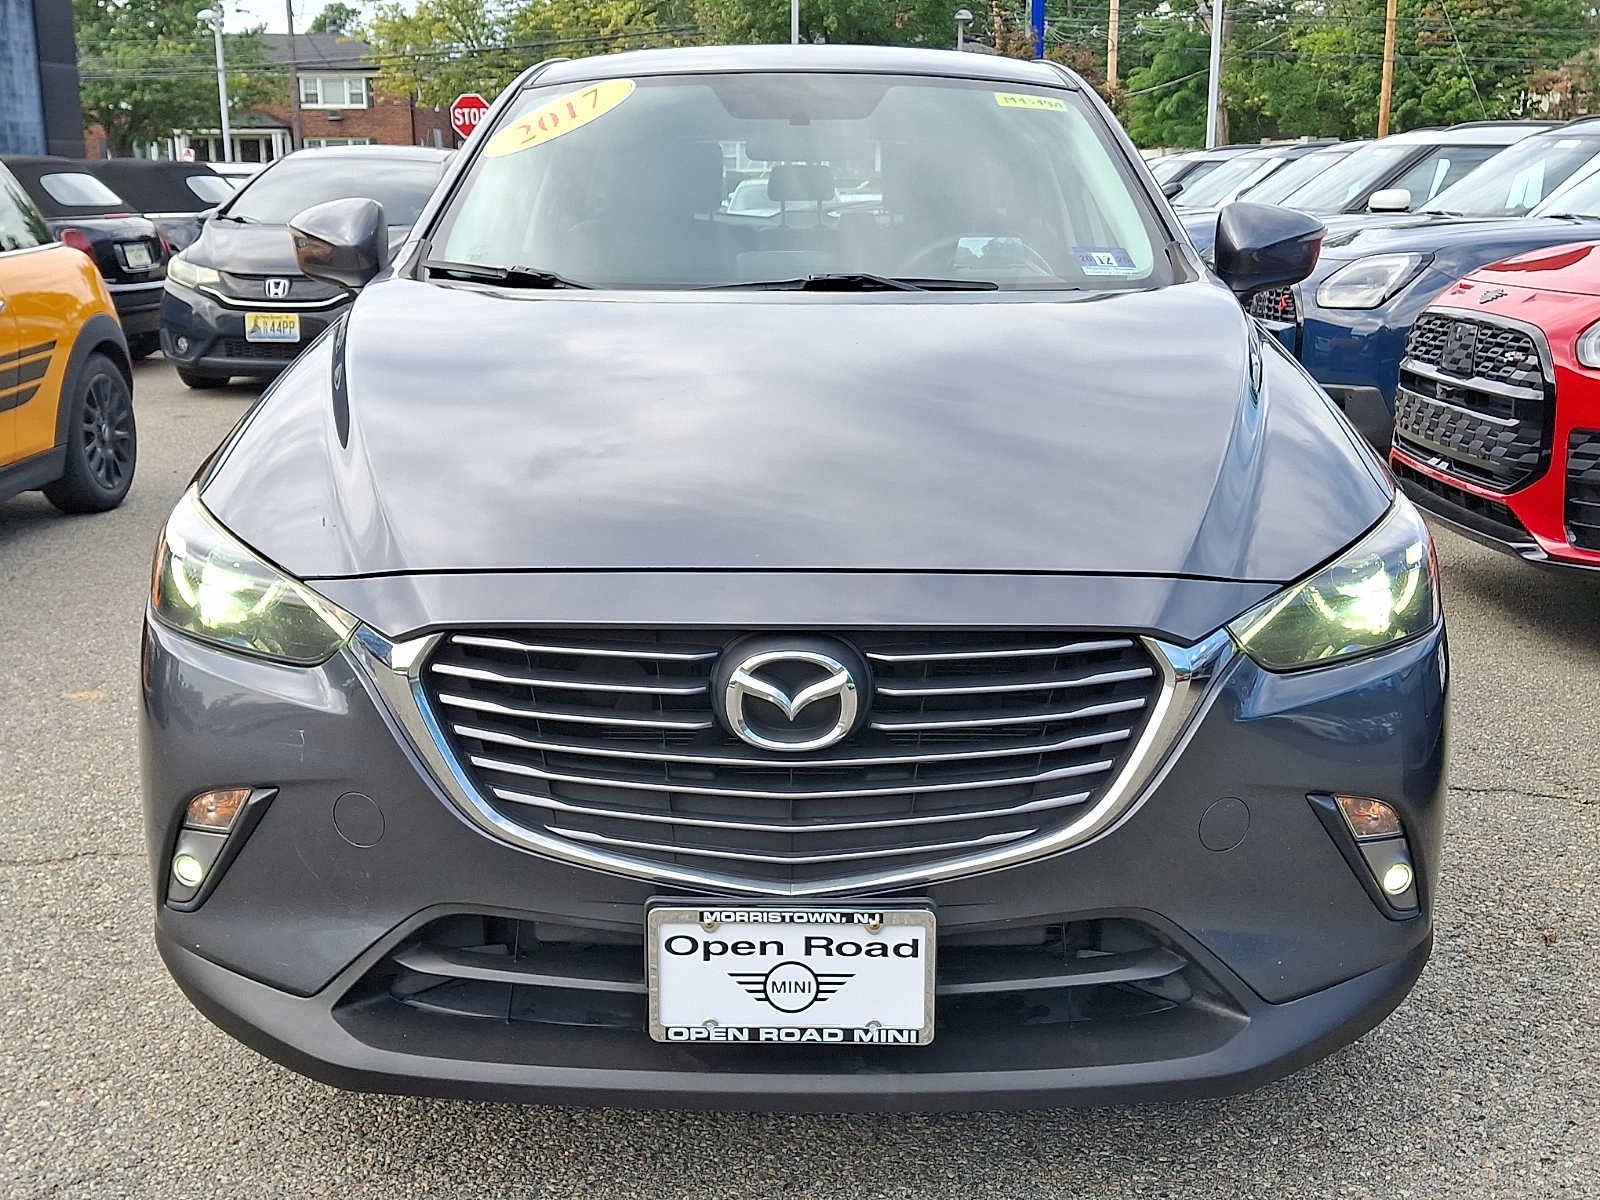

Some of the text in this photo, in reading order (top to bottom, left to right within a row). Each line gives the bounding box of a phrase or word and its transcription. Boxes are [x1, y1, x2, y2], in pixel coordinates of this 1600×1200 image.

[454, 108, 488, 125] STOP
[518, 89, 598, 144] 2017
[702, 911, 881, 924] MORRISTOWN, NJ
[664, 935, 919, 961] Open Road
[771, 981, 812, 994] MINI
[667, 1027, 918, 1043] OPEN ROAD MINI
